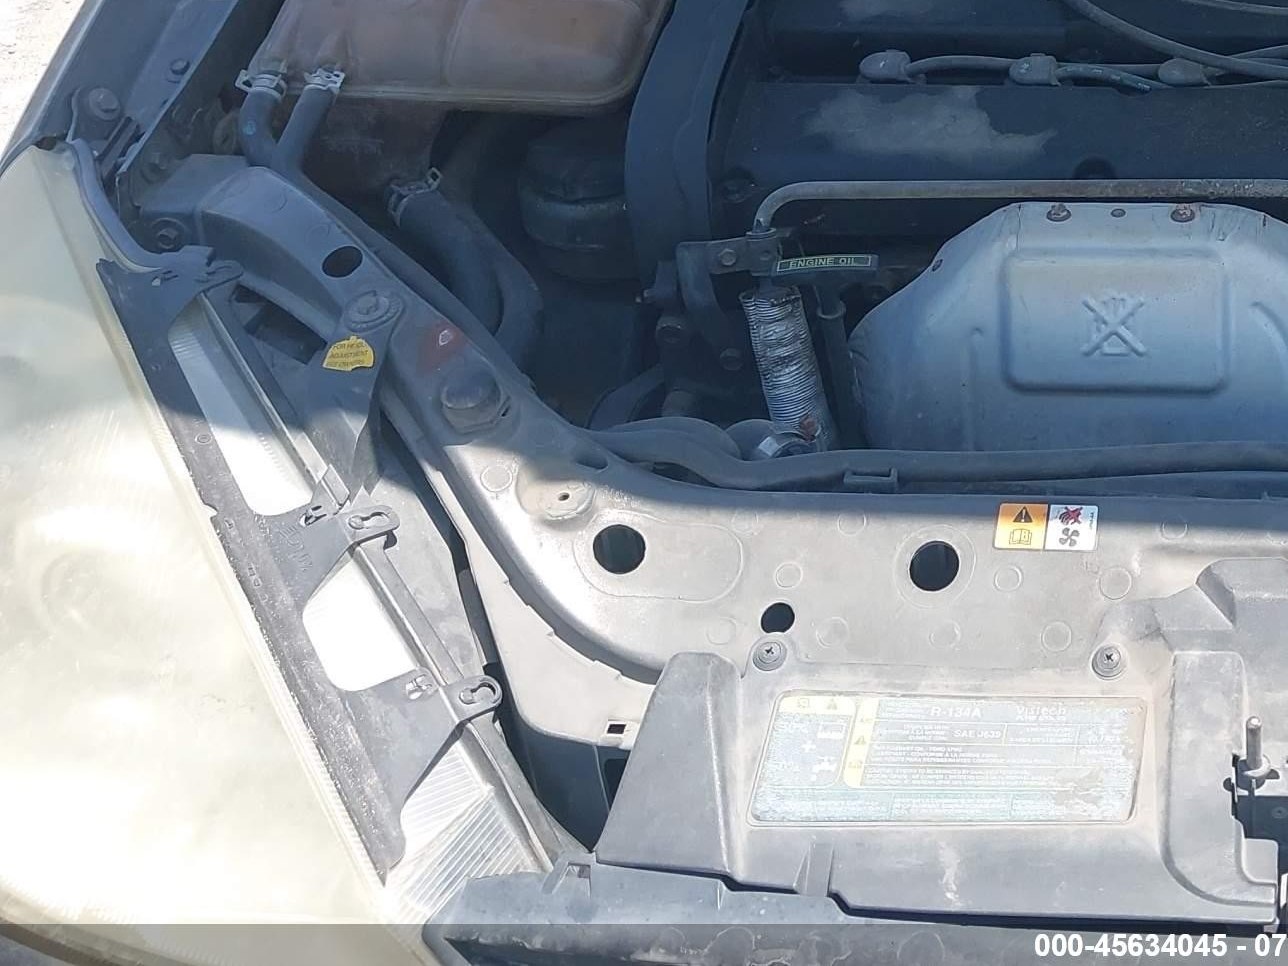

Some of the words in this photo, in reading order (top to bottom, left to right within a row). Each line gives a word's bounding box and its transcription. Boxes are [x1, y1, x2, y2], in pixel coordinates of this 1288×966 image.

[790, 257, 834, 268] ENGINE
[839, 257, 854, 266] OIL
[930, 706, 982, 719] R-134A
[952, 729, 976, 738] SAE
